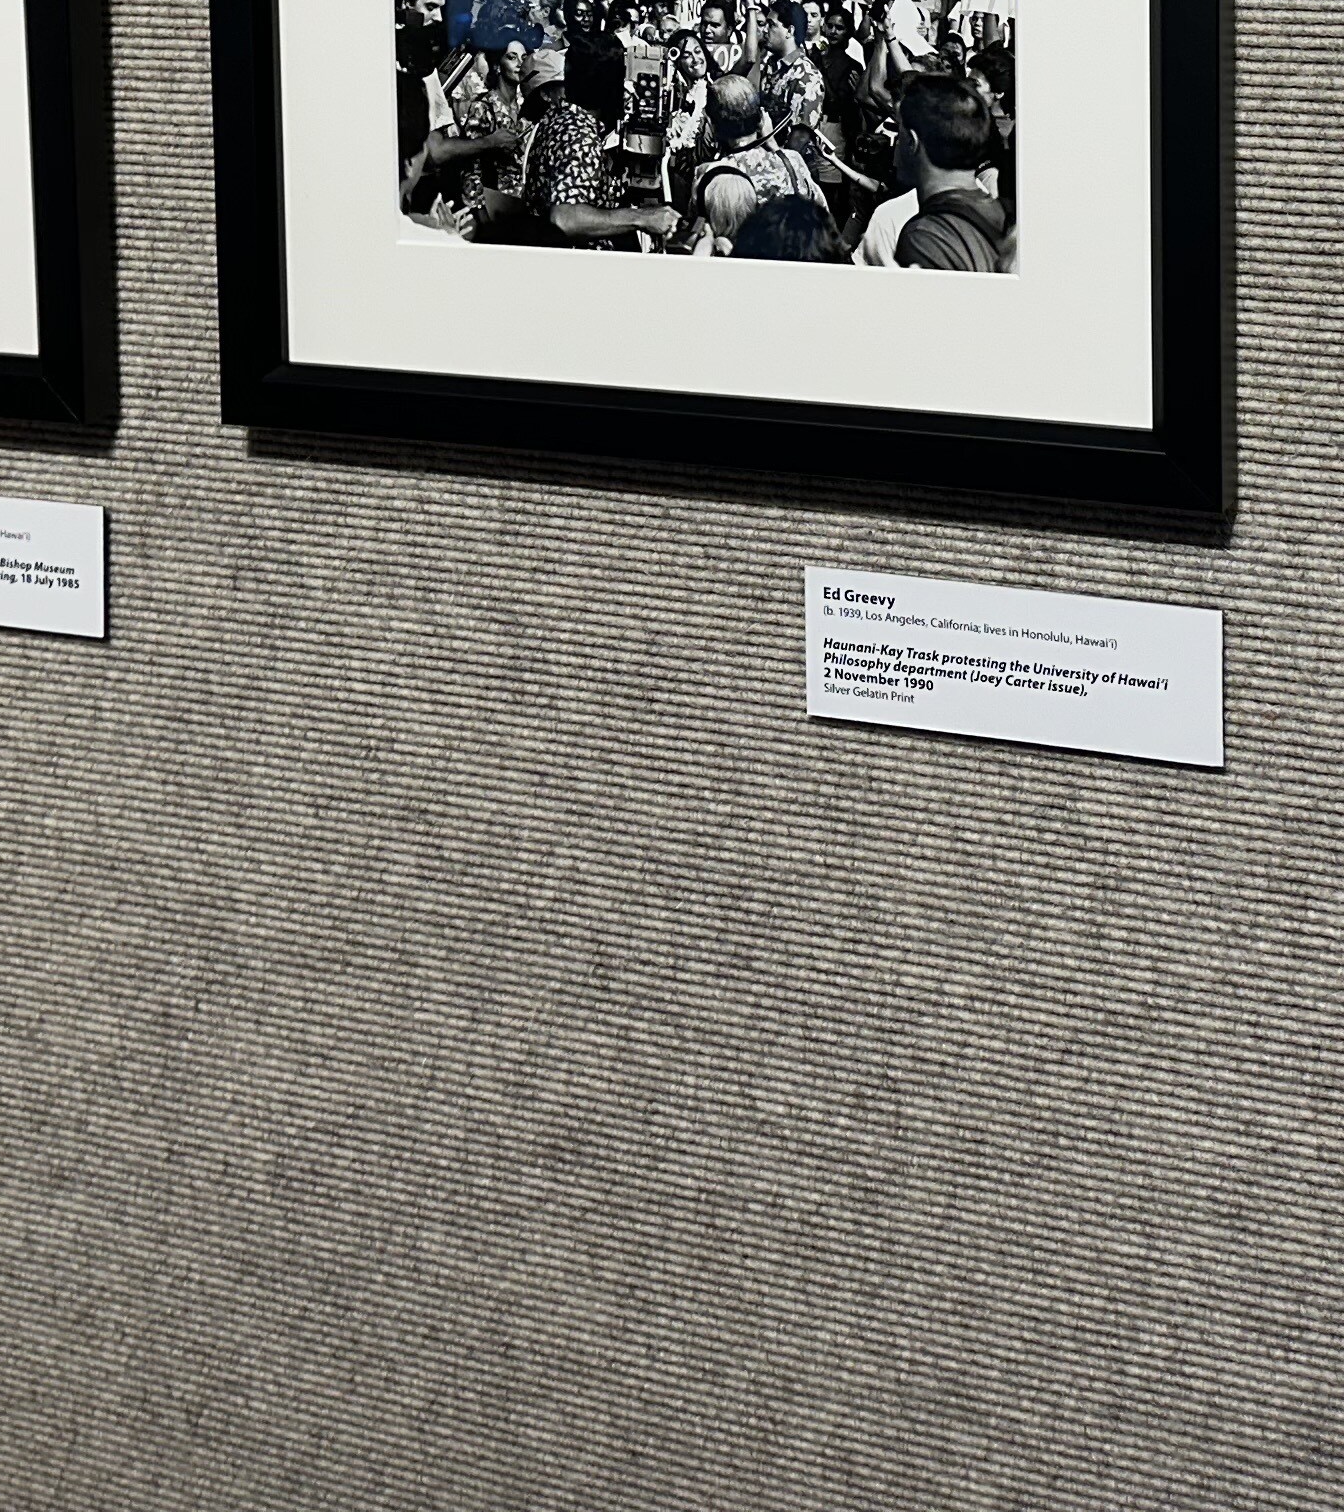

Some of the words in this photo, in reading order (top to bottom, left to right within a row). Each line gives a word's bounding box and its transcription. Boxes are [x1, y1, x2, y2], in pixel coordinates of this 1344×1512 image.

[0, 557, 32, 572] Bishop
[34, 561, 75, 575] Museum
[21, 573, 32, 584] 18
[34, 574, 54, 588] July
[56, 577, 80, 589] 1985
[823, 587, 840, 601] Ed
[844, 589, 895, 610] Greevy
[839, 607, 863, 620] 1939,
[865, 610, 883, 621] Los
[884, 613, 928, 627] Angeles,
[930, 617, 981, 634] California;
[983, 623, 1007, 636] lives
[1009, 629, 1019, 637] in
[1021, 628, 1073, 645] Honolulu,
[823, 637, 904, 660] Haunani-Kay
[906, 647, 939, 662] Trask
[941, 654, 1007, 673] protesting
[1010, 660, 1030, 673] the
[1033, 662, 1099, 684] University
[1101, 672, 1117, 684] of
[823, 652, 891, 673] Philosophy
[893, 661, 968, 680] department
[970, 670, 1003, 688] (Joey
[1005, 674, 1046, 690] Carter
[1047, 679, 1088, 697] issue),
[824, 667, 831, 678] 2
[834, 668, 900, 686] November
[904, 677, 934, 691] 1990
[824, 682, 851, 695] Silver
[852, 686, 888, 700] Gelatin
[891, 691, 915, 703] Print
